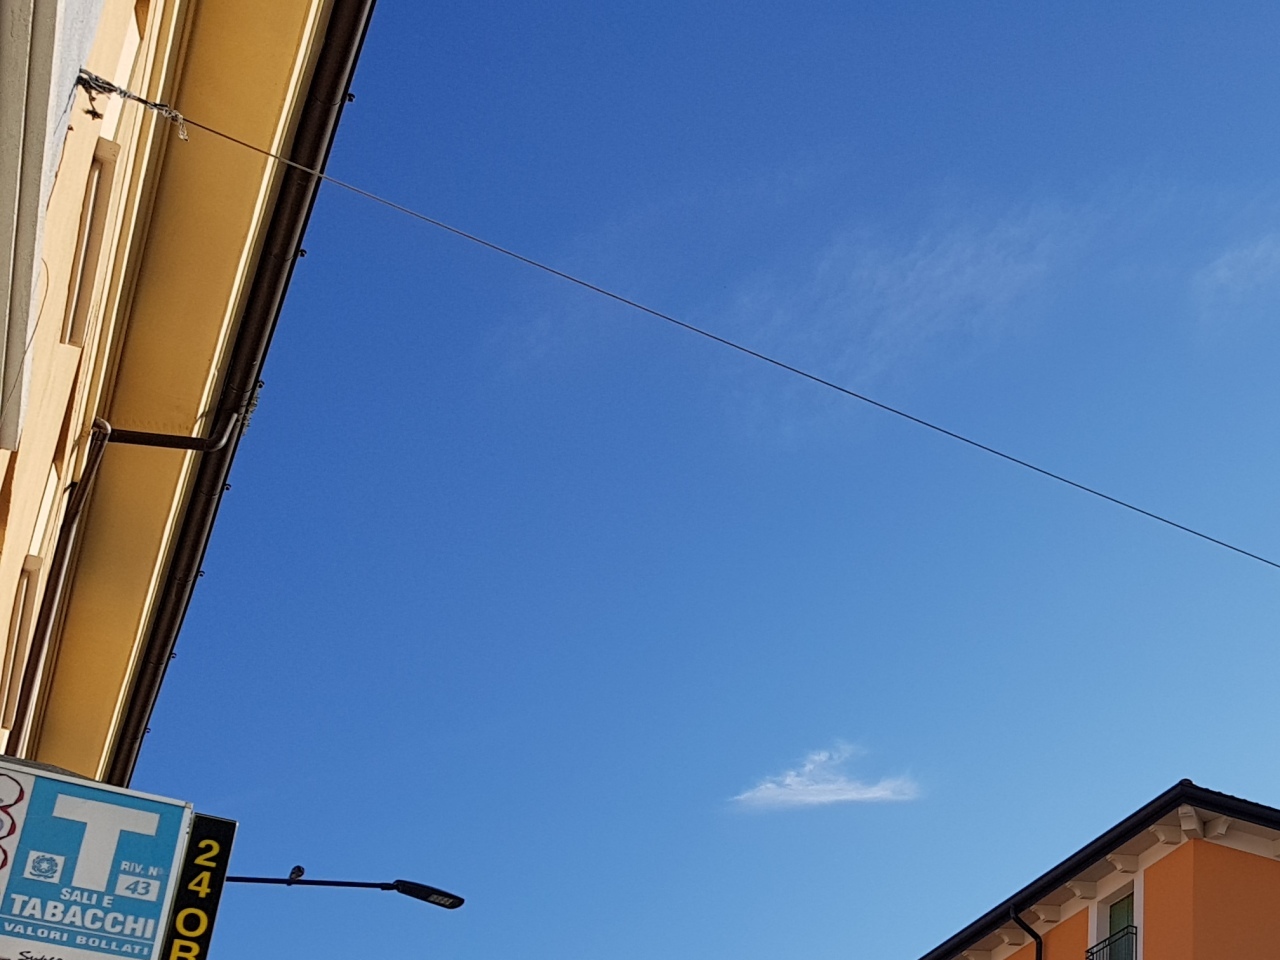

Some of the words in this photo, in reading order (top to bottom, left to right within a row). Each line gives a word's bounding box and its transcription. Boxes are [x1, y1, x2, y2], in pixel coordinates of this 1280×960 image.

[52, 793, 160, 892] T
[120, 860, 145, 875] RIV.
[60, 887, 99, 906] SALI
[101, 895, 115, 908] E
[125, 879, 152, 896] 43
[10, 893, 156, 939] TABACCHI
[3, 922, 69, 942] VALORI
[75, 934, 151, 956] BOLLATI
